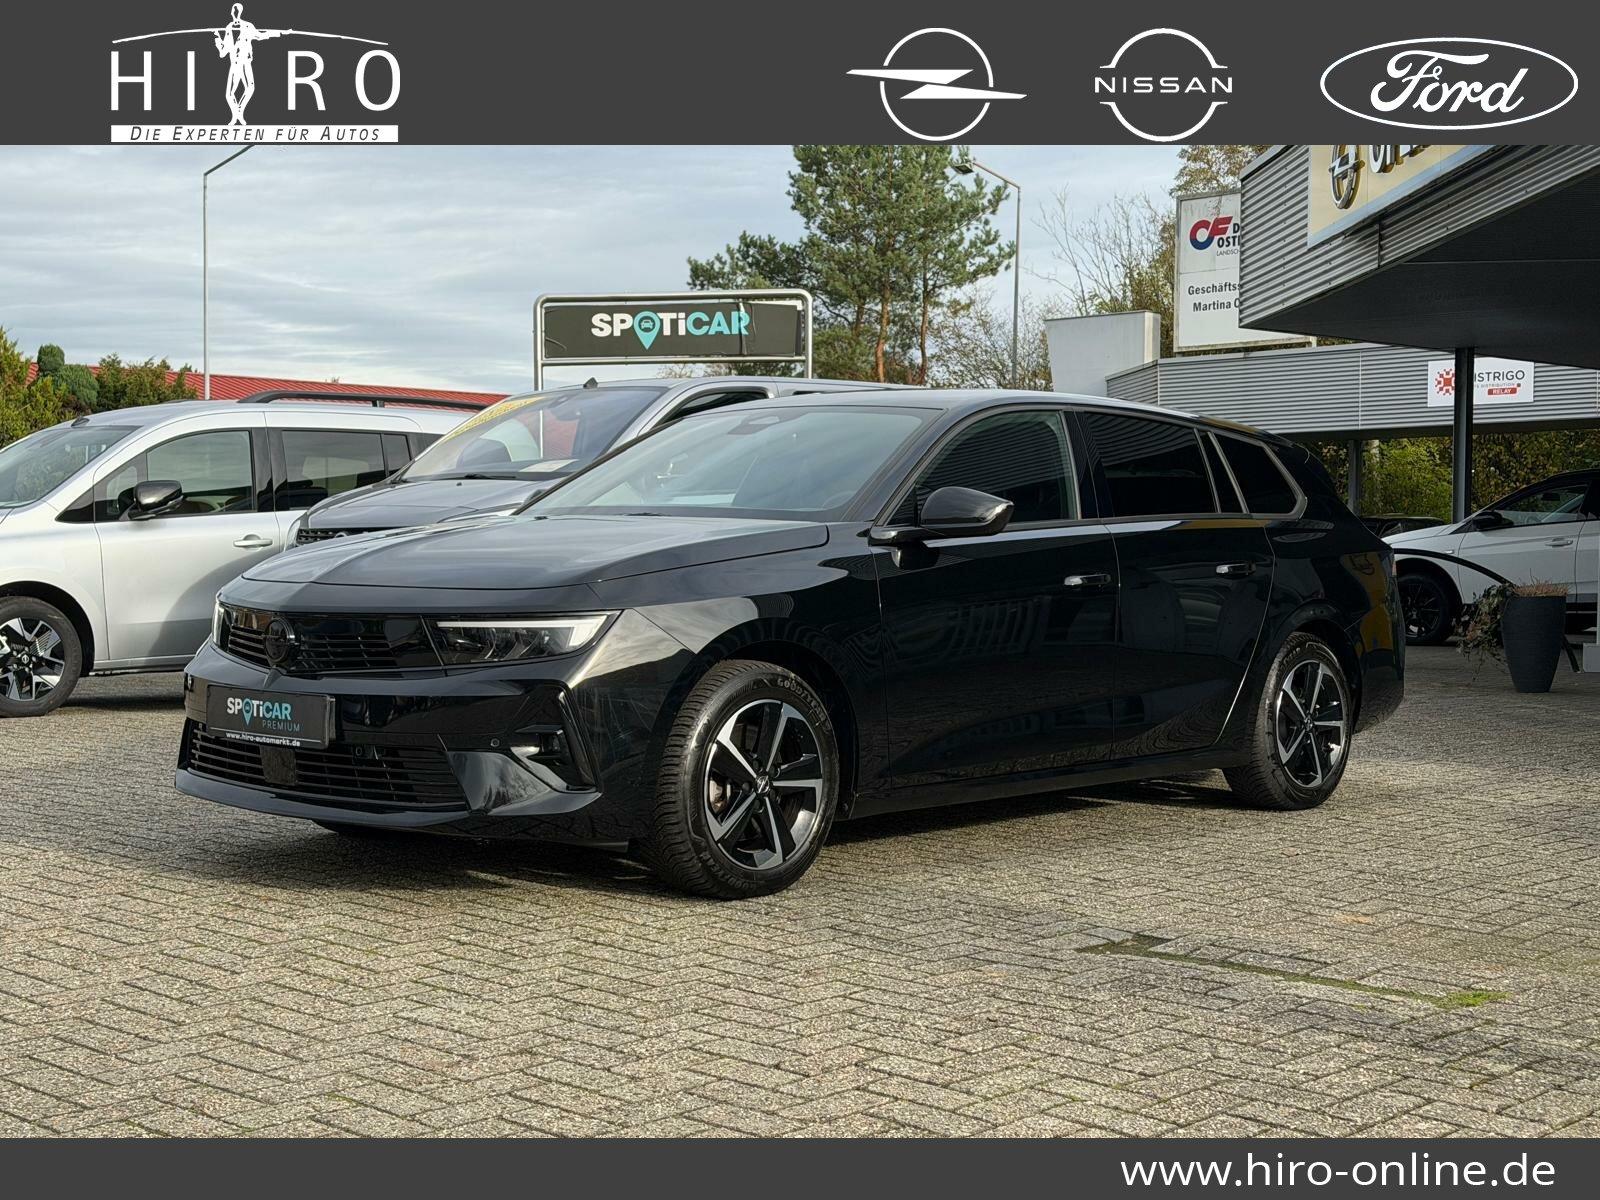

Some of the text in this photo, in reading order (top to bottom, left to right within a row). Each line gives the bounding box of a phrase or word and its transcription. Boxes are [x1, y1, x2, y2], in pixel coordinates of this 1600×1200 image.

[1193, 299, 1231, 312] Martina
[1474, 369, 1525, 382] ISTRIGO
[262, 719, 300, 732] PREMIUM
[226, 732, 301, 747] www.hiro-automarkt.de
